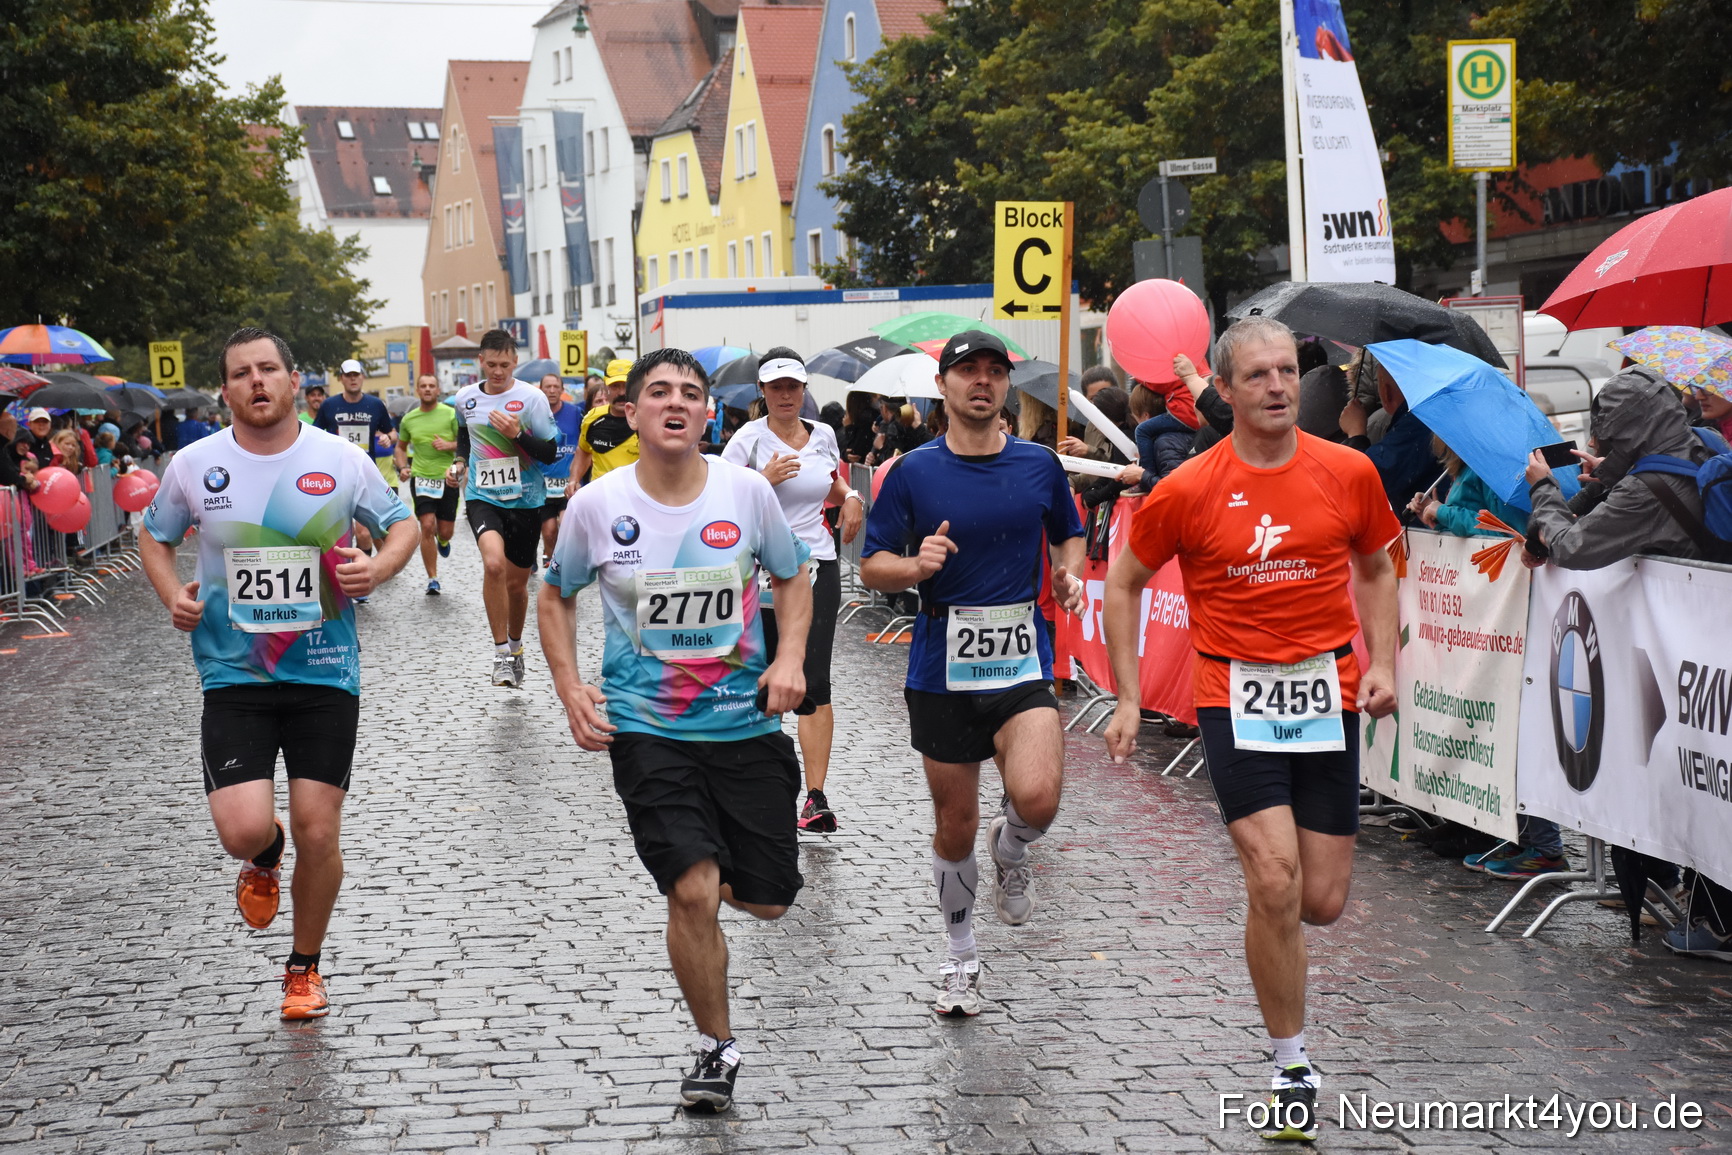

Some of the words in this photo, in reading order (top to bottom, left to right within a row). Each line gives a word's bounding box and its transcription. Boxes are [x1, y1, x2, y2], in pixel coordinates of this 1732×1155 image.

[1470, 62, 1493, 88] H
[1462, 104, 1503, 114] Marktplatz
[1170, 163, 1190, 172] Ulmer
[1192, 161, 1213, 170] Gasse
[1543, 170, 1644, 224] ANTON
[1005, 207, 1063, 228] Block
[672, 223, 691, 243] HOTEL
[1013, 237, 1052, 295] C
[563, 332, 584, 341] Block
[153, 344, 178, 353] Block
[567, 345, 580, 366] D
[159, 356, 175, 378] D
[348, 432, 361, 442] 54
[302, 478, 332, 490] Hervis
[418, 478, 442, 489] 2799
[481, 467, 517, 486] 2114
[204, 496, 232, 506] PARTL
[205, 503, 232, 512] Neumarkt
[1228, 500, 1249, 508] erima
[707, 528, 738, 542] Hervis
[267, 549, 312, 560] BOCK
[613, 550, 642, 560] PARTL
[684, 568, 734, 582] BOCK
[1227, 559, 1307, 578] funrunners
[1248, 567, 1318, 585] neumarkt
[1419, 560, 1460, 587] Service-Line:
[236, 568, 313, 600] 2514
[649, 588, 734, 625] 2770
[990, 605, 1028, 620] BOCK
[253, 608, 298, 621] Markus
[306, 631, 327, 646] 17.
[672, 632, 714, 647] Malek
[957, 623, 1031, 658] 2576
[307, 645, 349, 656] Neumarkter
[307, 655, 345, 666] Stadtlauf
[971, 666, 1019, 678] Thomas
[1240, 666, 1274, 674] NeuerMarkt
[1243, 678, 1332, 716] 2459
[1414, 680, 1495, 732] Gebäudereinigung
[1274, 725, 1303, 740] Uwe
[1413, 722, 1495, 768] Hausmeisterdienst
[1678, 746, 1732, 804] WENIG
[1414, 764, 1501, 816] Arbeitsbühnenverleih
